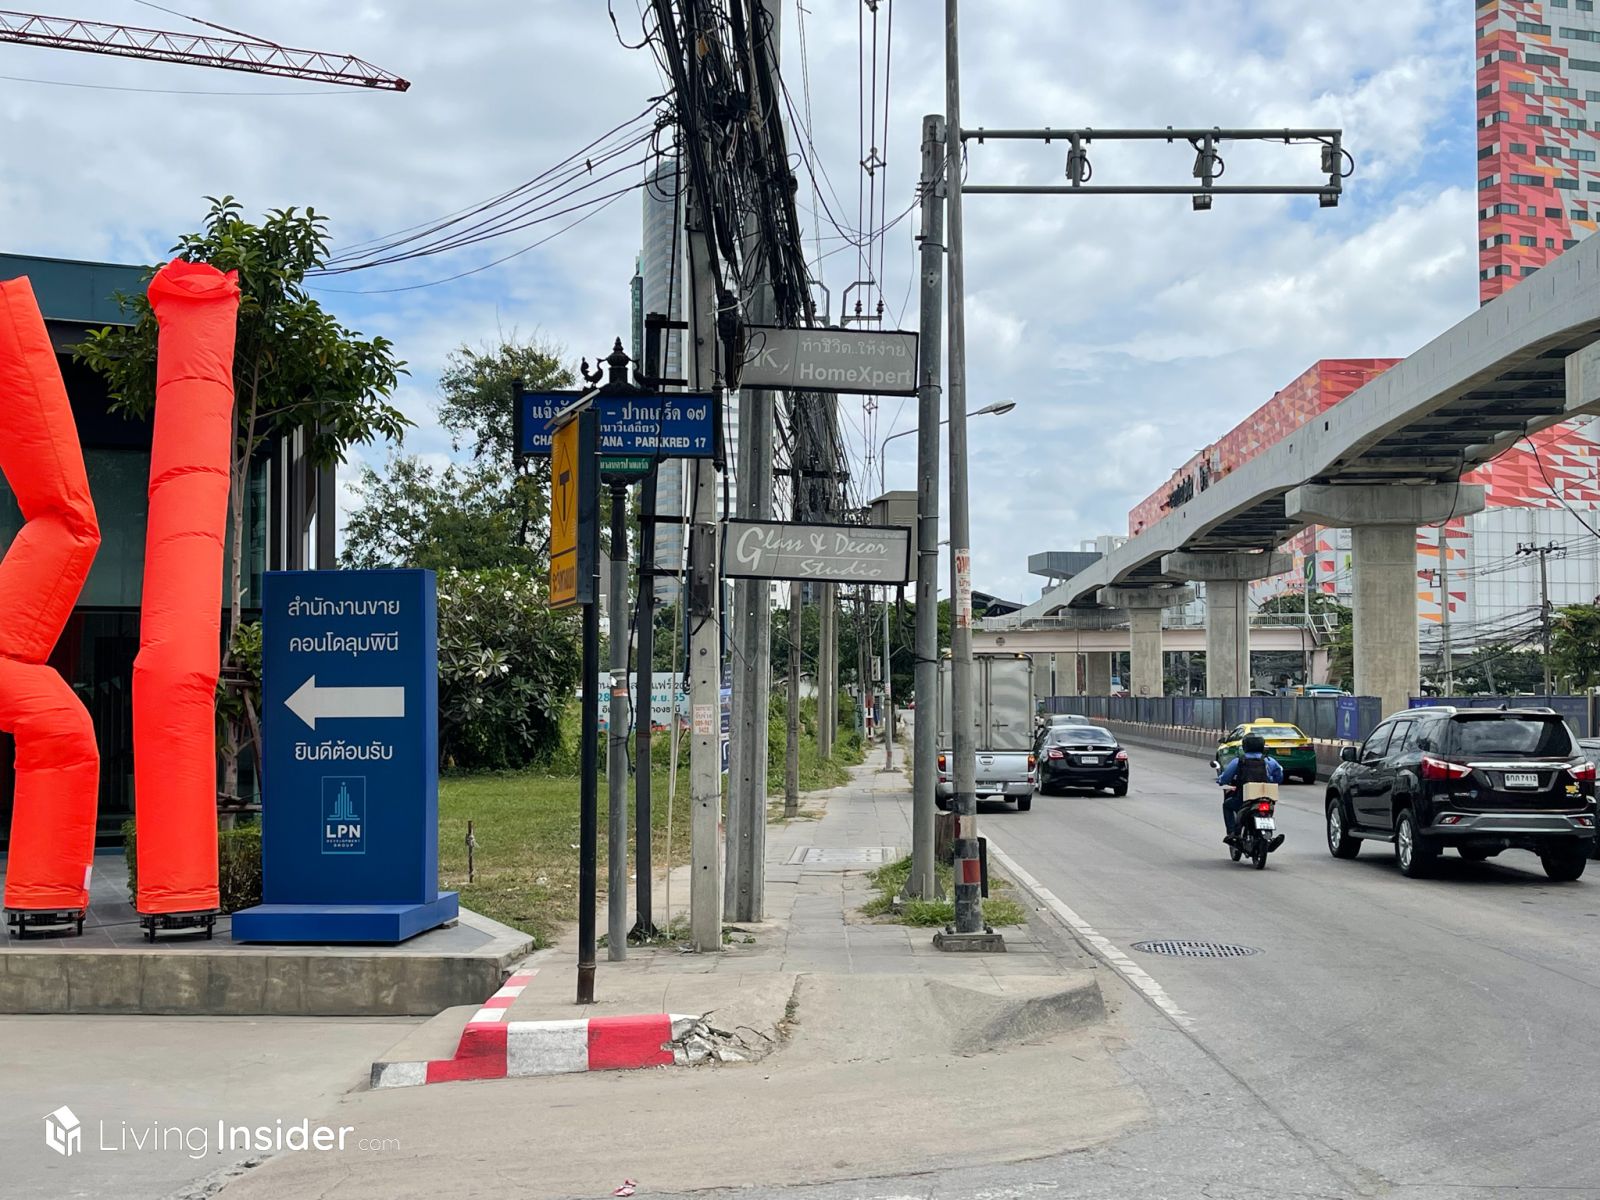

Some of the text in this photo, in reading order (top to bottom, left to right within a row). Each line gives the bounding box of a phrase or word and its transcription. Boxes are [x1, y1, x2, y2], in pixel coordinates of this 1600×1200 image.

[800, 362, 912, 386] HomeXpert
[599, 420, 661, 435] นาวีเสถียร)
[693, 436, 707, 448] 17
[735, 526, 806, 572] Glass
[835, 532, 889, 556] Decor
[799, 558, 882, 577] Studio
[287, 595, 400, 616] สำนักงานขาย
[289, 631, 399, 658] คอนโดลุมพินี
[294, 740, 394, 761] ยินดีต้อนรับ
[326, 824, 361, 838] LPN
